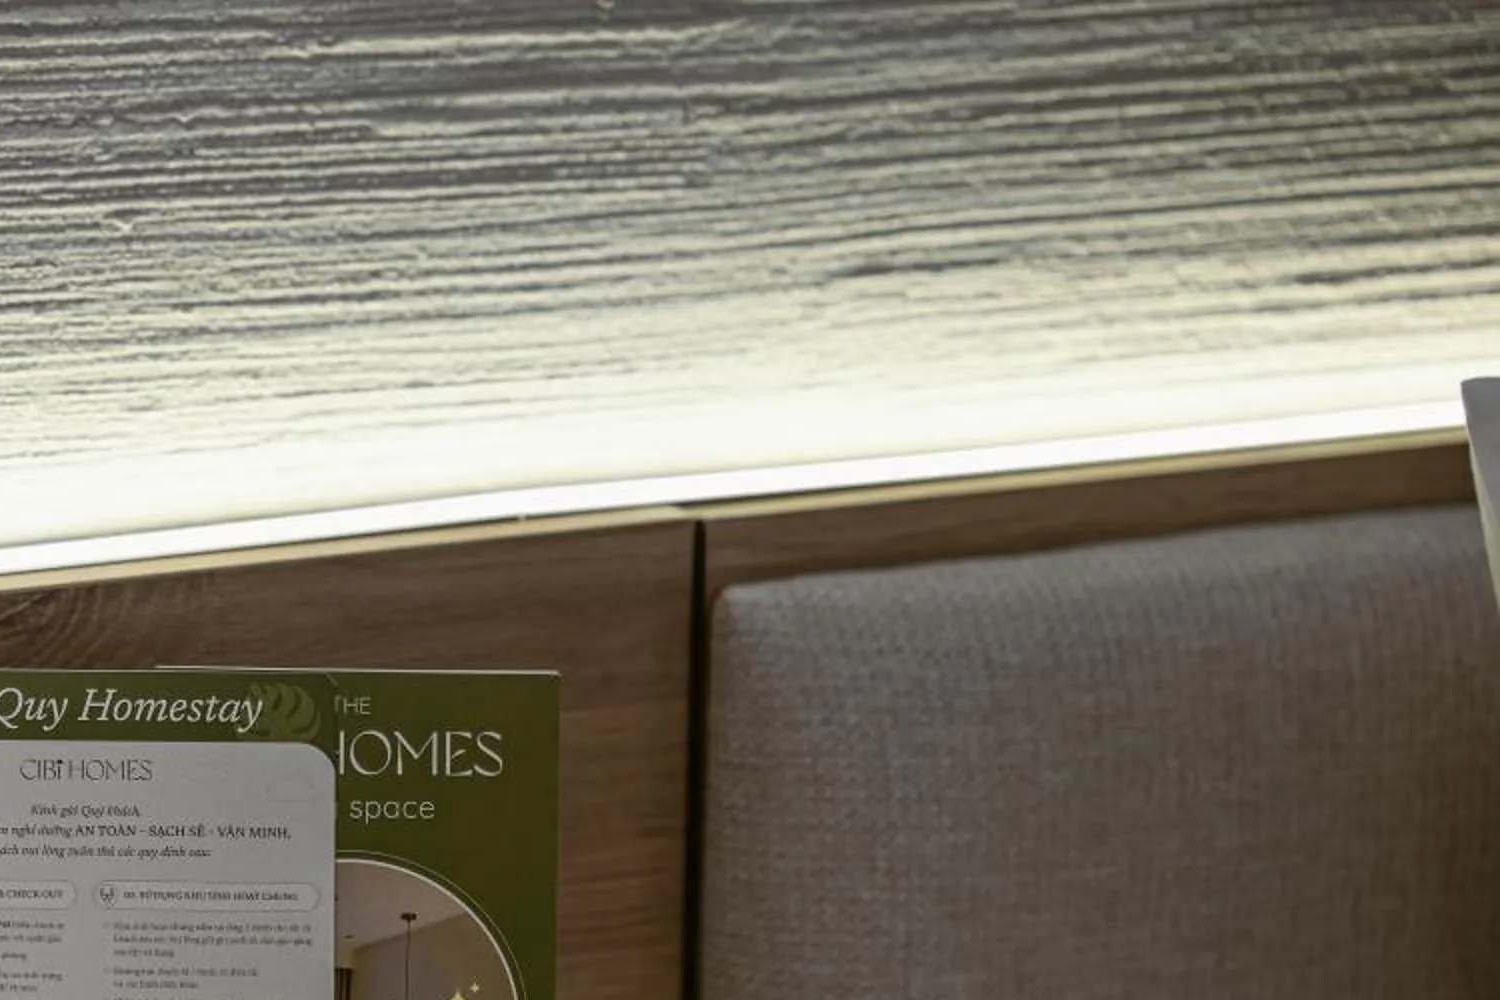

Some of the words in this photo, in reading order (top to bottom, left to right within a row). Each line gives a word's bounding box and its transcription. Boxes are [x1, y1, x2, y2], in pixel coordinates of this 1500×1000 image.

[78, 688, 264, 734] Homestay
[67, 758, 154, 782] HOMES
[349, 799, 436, 825] space
[75, 824, 95, 836] AN
